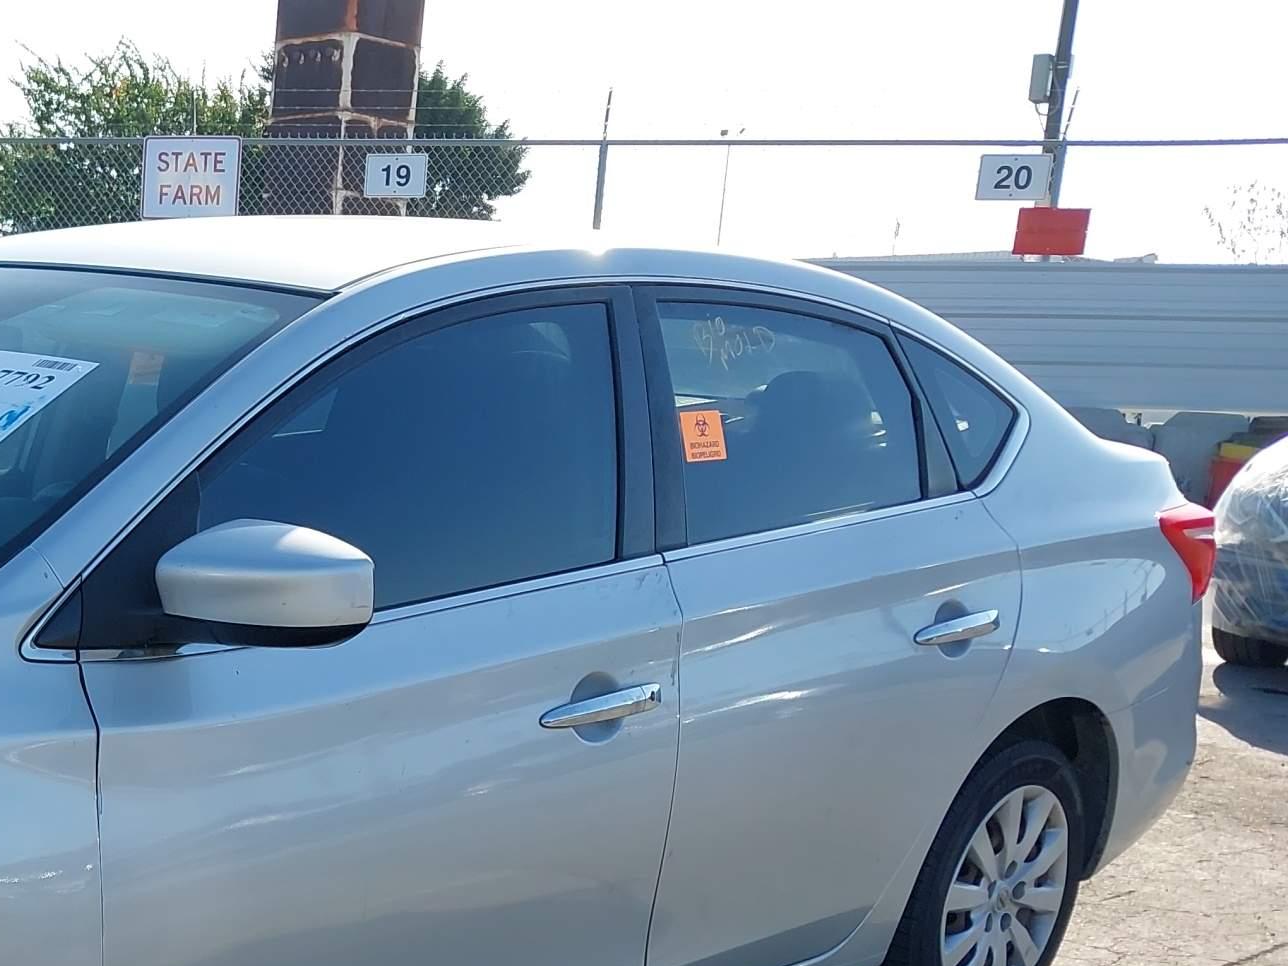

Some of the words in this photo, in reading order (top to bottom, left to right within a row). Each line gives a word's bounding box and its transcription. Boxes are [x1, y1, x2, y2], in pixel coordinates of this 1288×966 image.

[157, 151, 226, 174] STATE
[380, 164, 412, 188] 19
[993, 165, 1033, 190] 20
[159, 184, 221, 206] FARM
